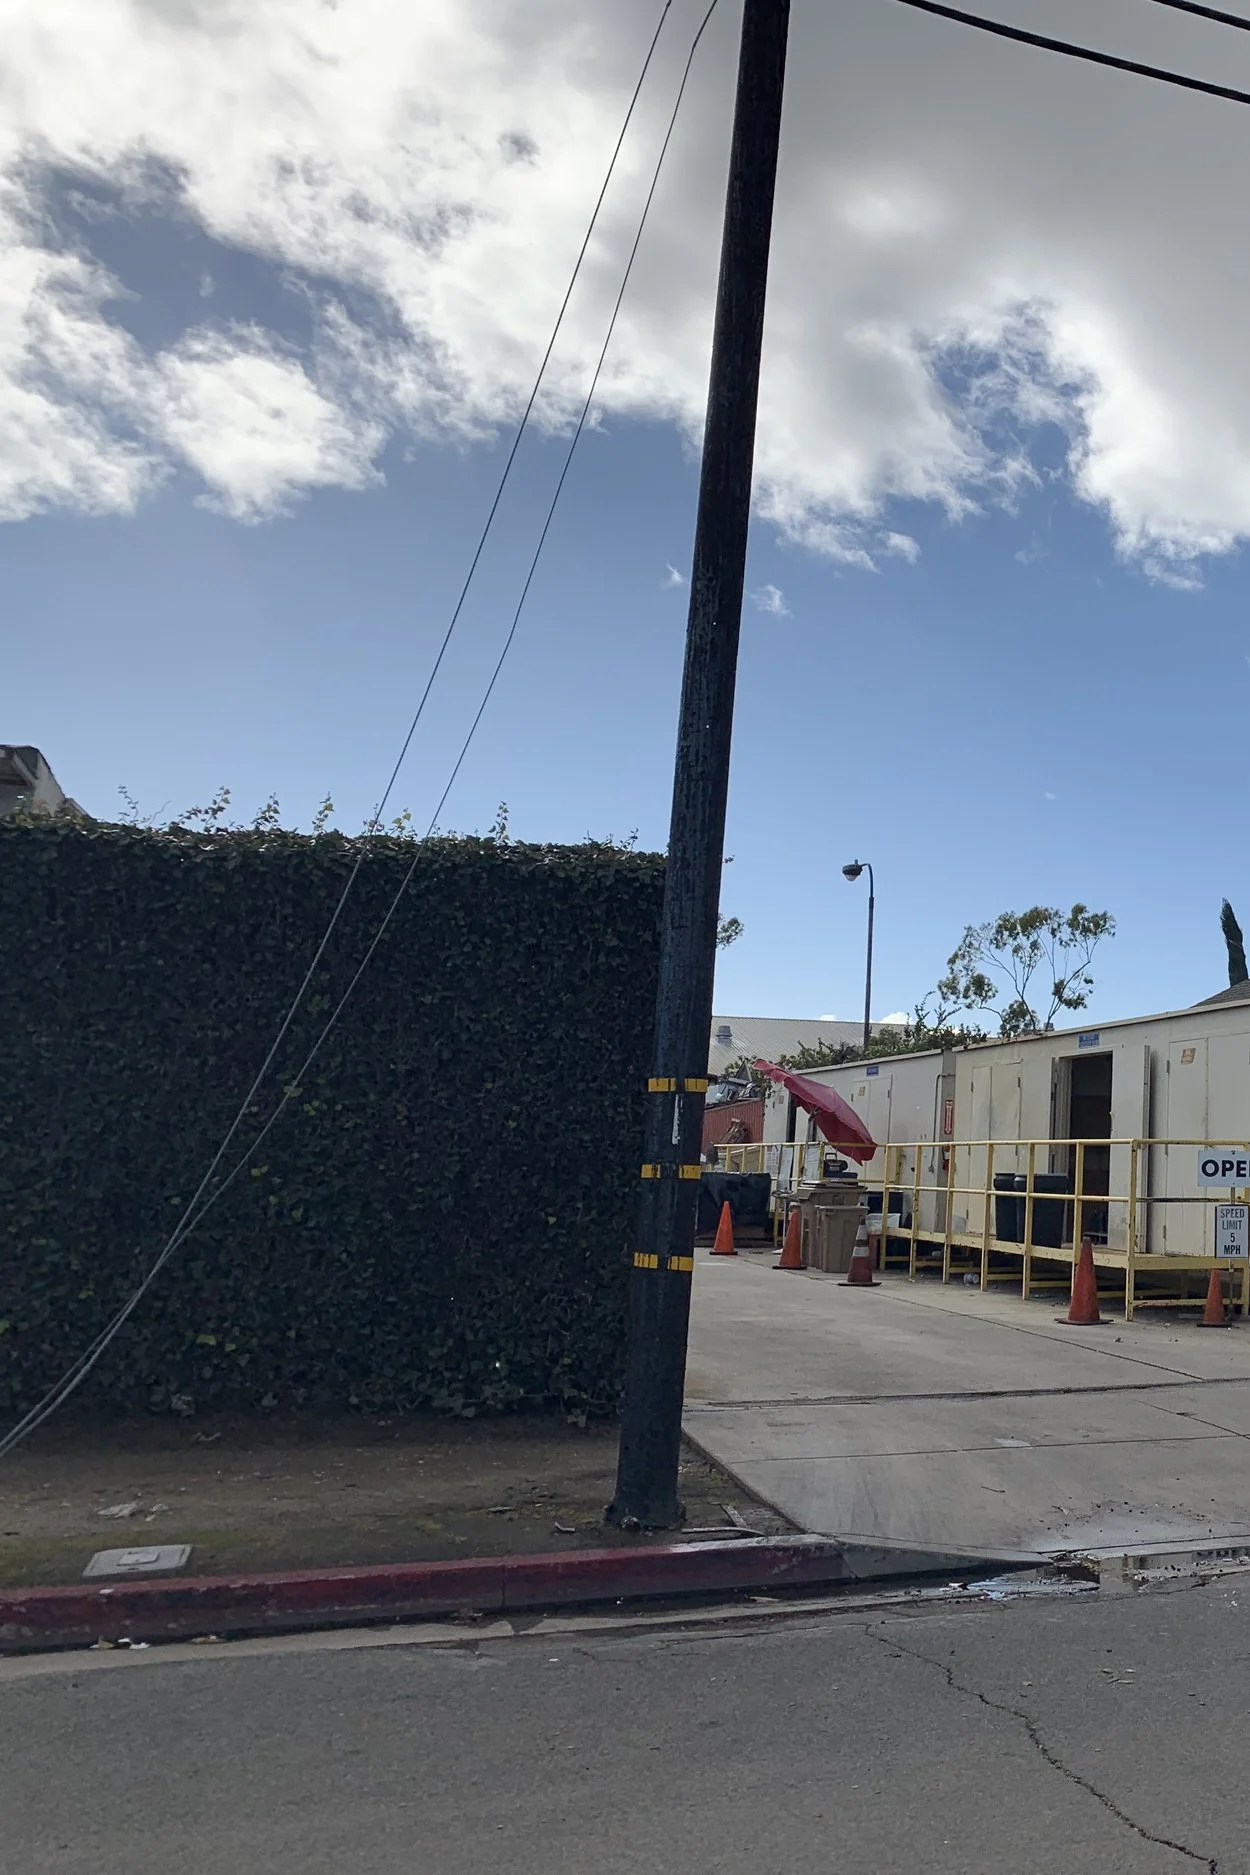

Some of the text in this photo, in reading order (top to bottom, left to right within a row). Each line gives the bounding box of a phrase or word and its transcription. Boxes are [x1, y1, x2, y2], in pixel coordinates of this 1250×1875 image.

[1220, 1208, 1245, 1219] SPEED
[1222, 1220, 1243, 1230] LIMIT
[1230, 1232, 1236, 1243] 5
[1223, 1244, 1241, 1255] MPH
